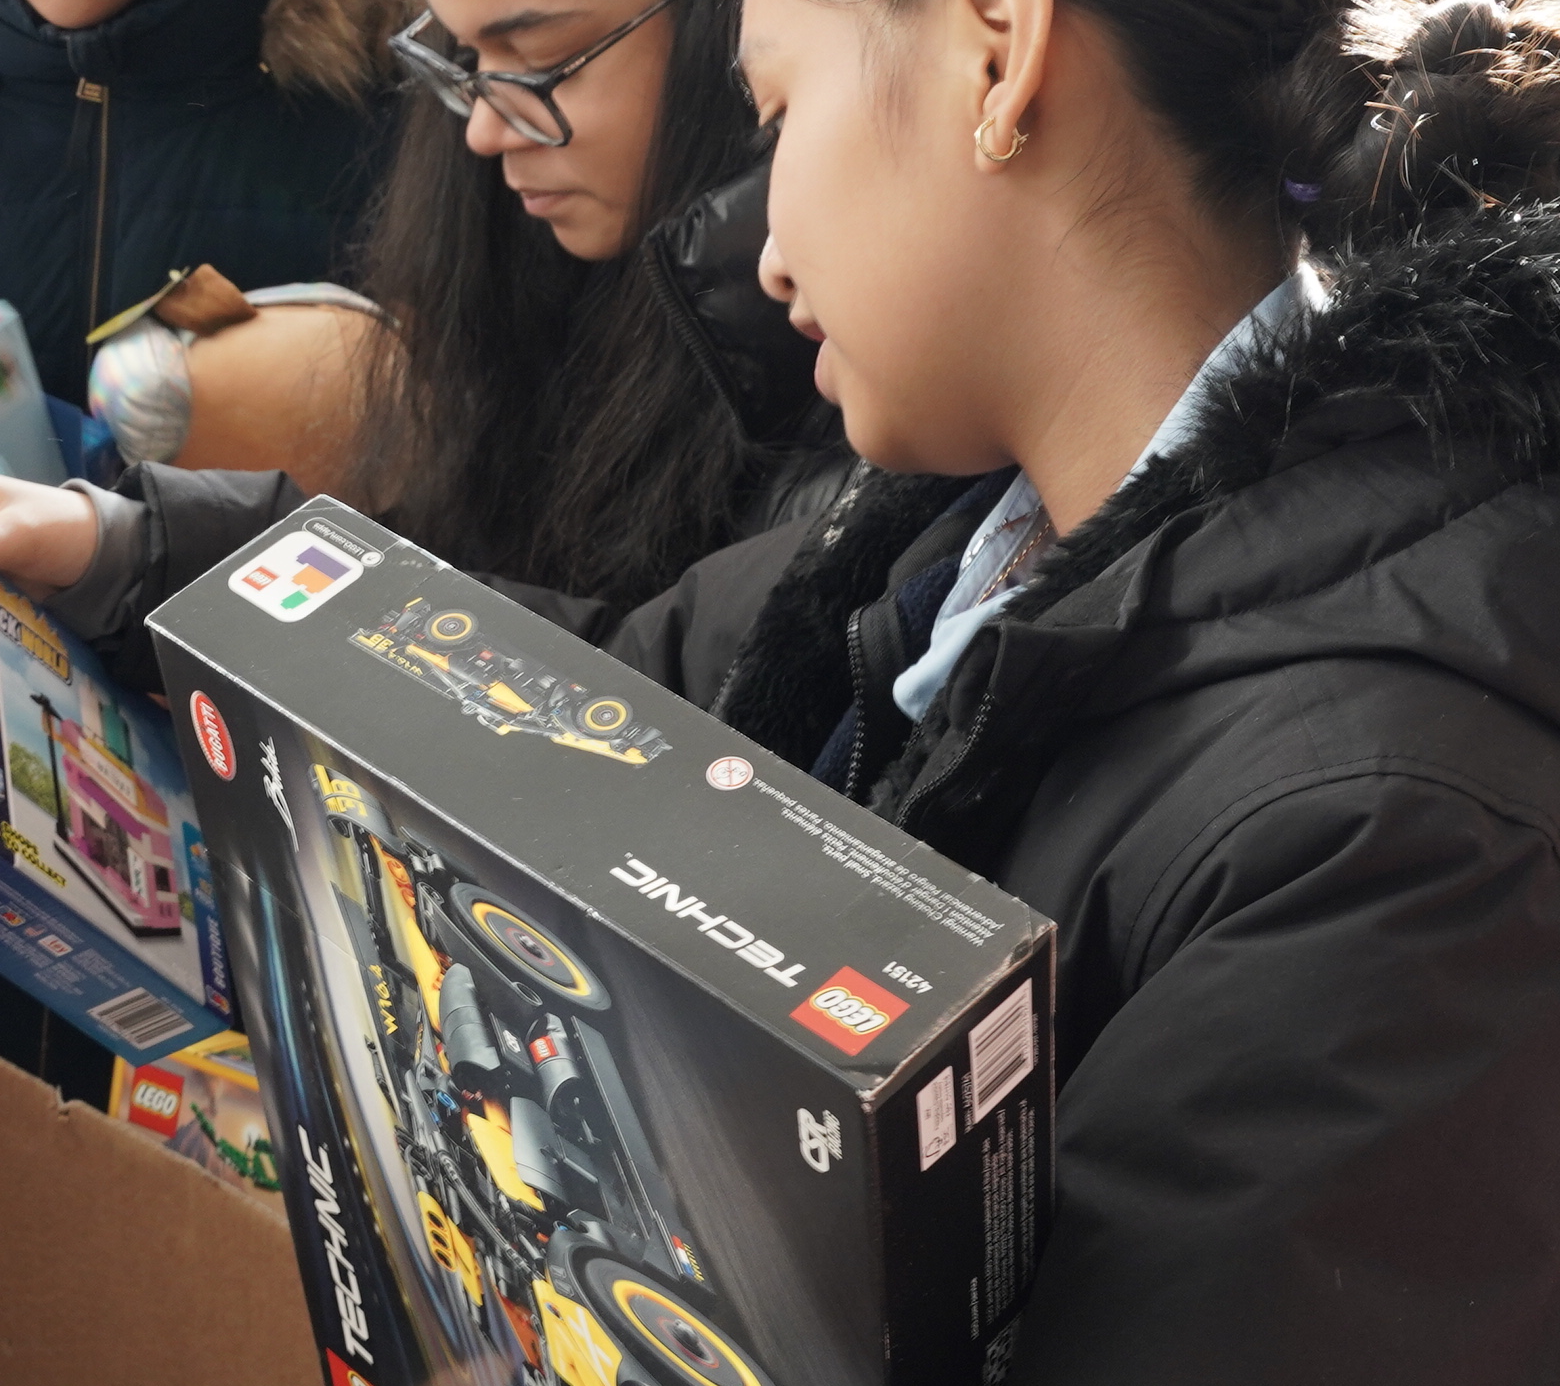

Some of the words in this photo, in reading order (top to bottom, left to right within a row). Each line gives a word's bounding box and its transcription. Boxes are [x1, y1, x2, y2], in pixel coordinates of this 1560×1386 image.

[200, 701, 228, 773] BUGATTI
[609, 858, 808, 988] TECHNIC
[882, 960, 933, 994] 42151
[811, 987, 889, 1034] LEGO
[134, 1083, 177, 1116] LEGO
[298, 1124, 374, 1365] TECHNIC
